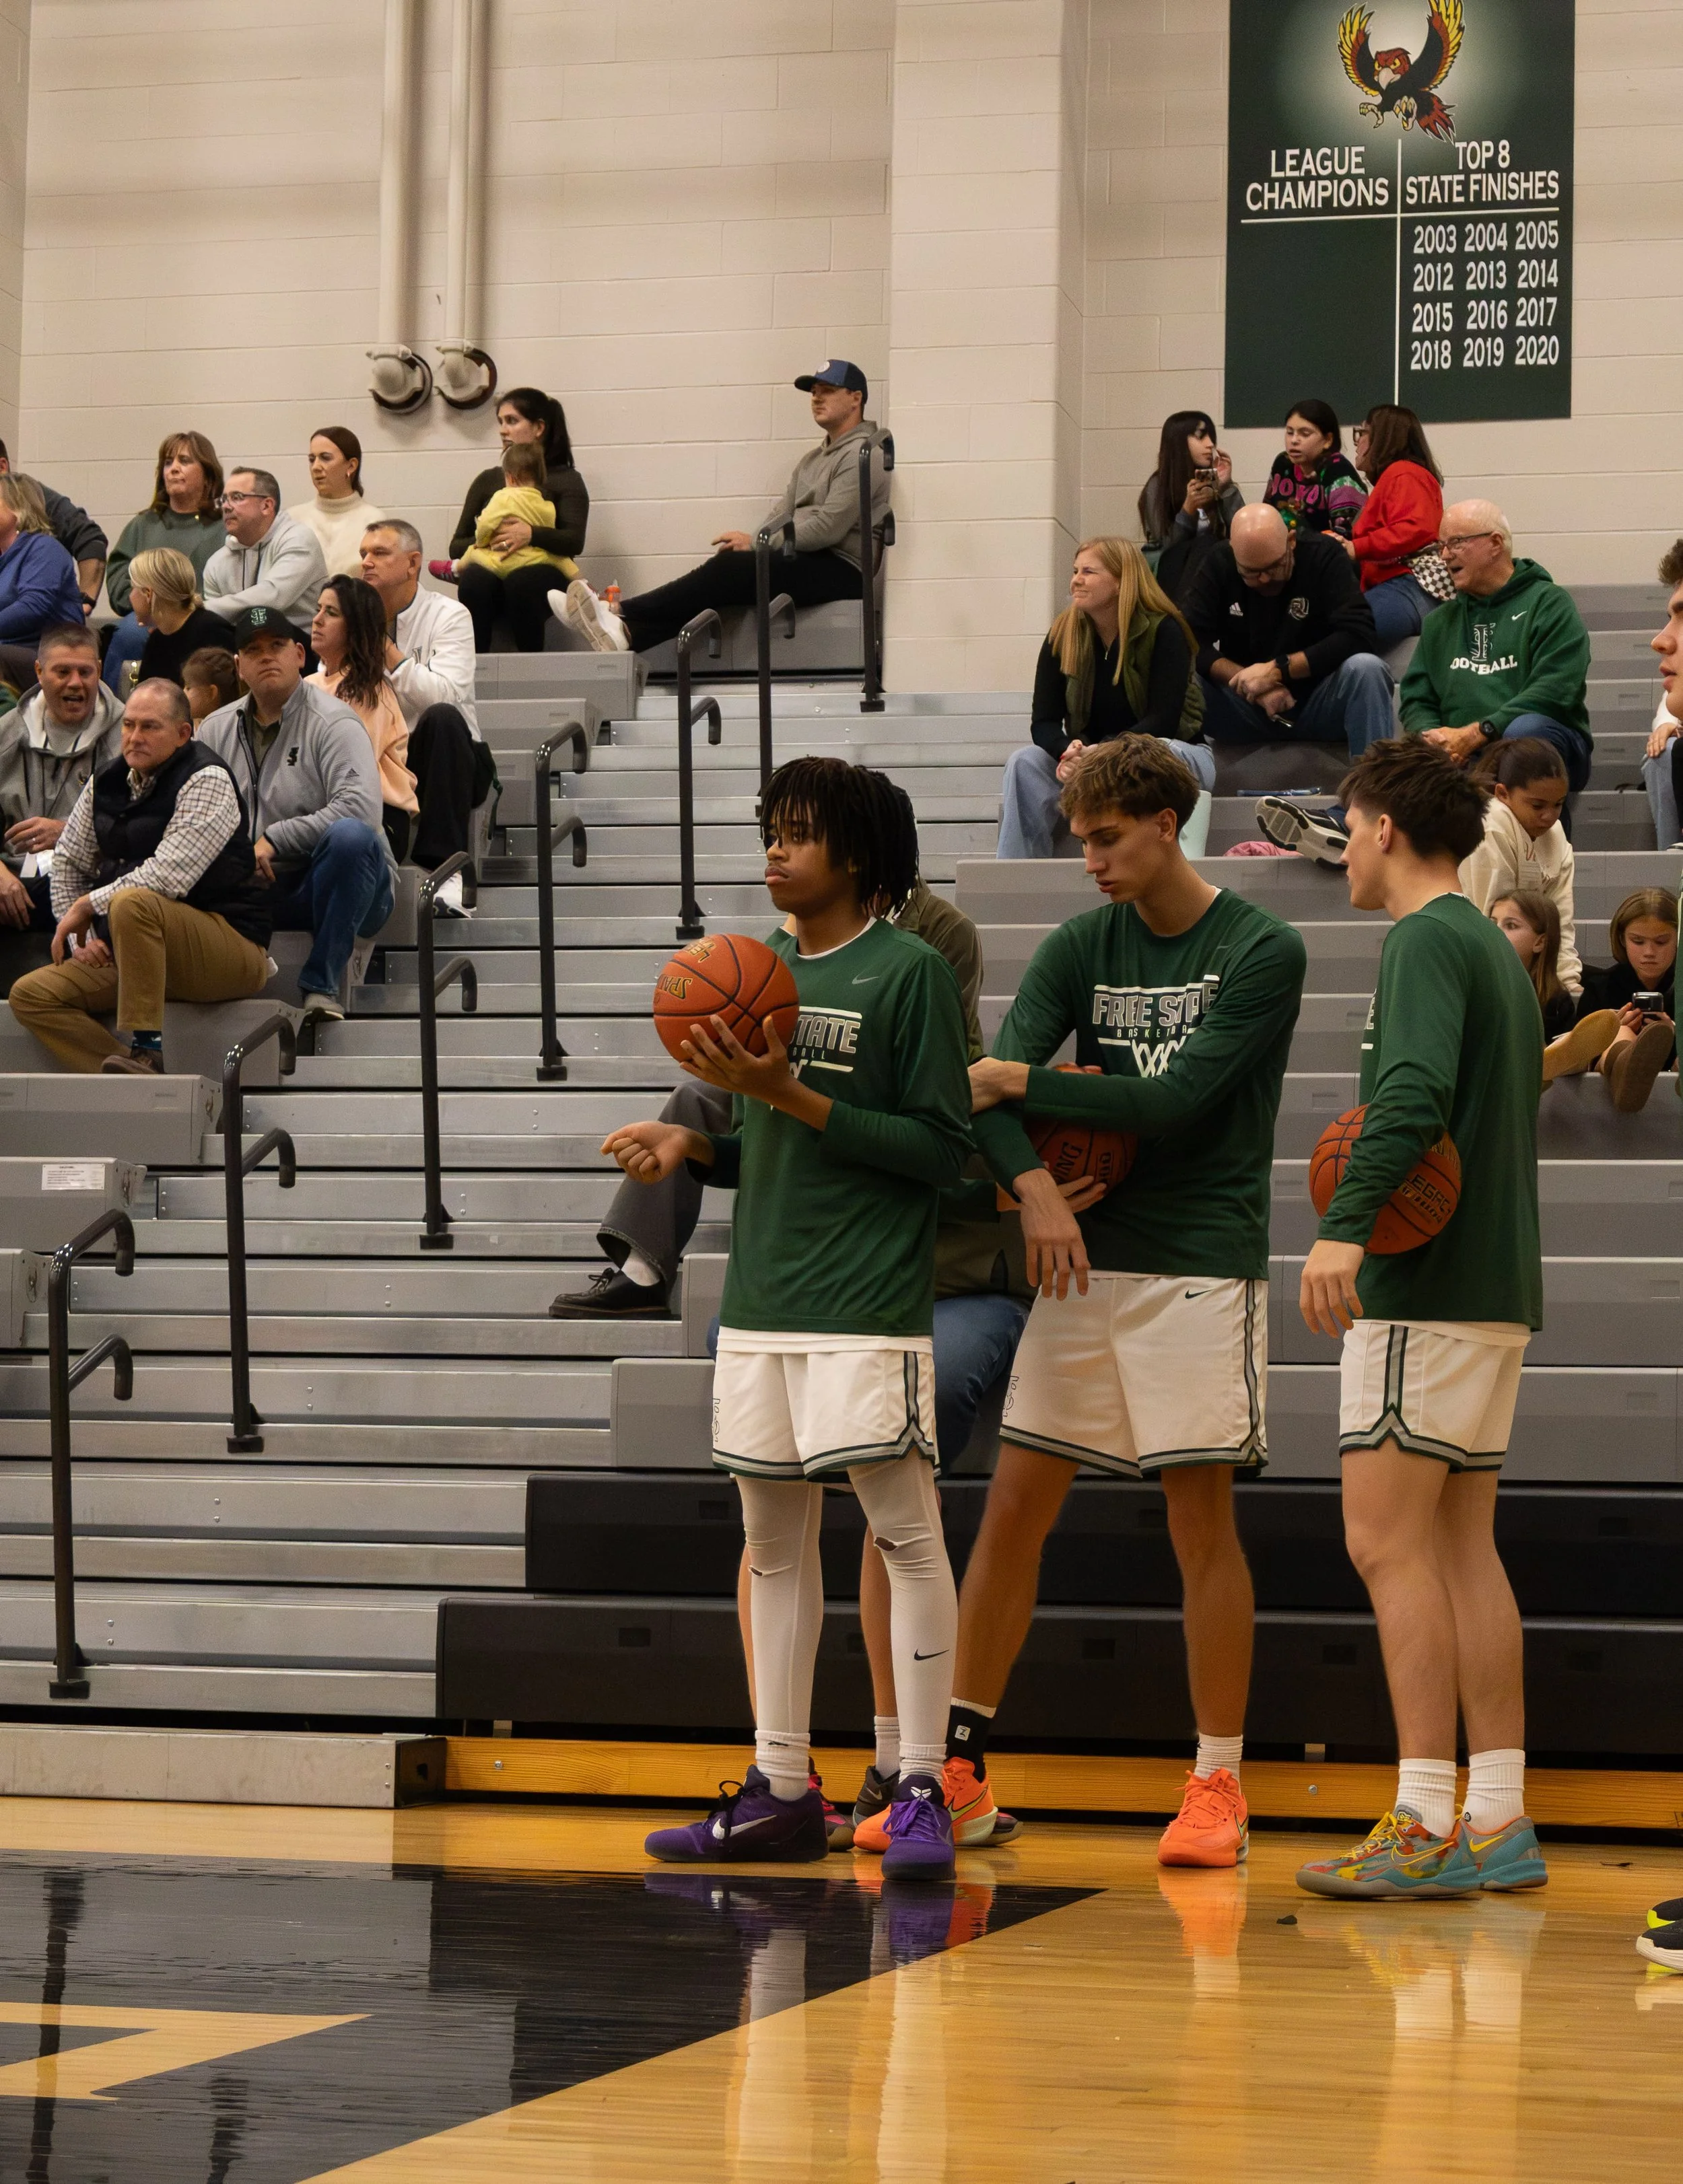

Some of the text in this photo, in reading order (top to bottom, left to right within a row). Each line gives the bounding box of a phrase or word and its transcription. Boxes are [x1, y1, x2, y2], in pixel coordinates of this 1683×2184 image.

[1271, 146, 1365, 177] LEAGUE
[1455, 140, 1510, 170] TOP 8
[1247, 178, 1389, 211] CHAMPIONS
[1406, 170, 1559, 204] STATE FINISHES
[1414, 220, 1558, 254] 2003 2004 2005
[1414, 259, 1558, 291] 2012 2013 2014
[1412, 297, 1557, 332] 2015 2016 2017
[1411, 335, 1558, 369] 2018 2019 2020
[1450, 655, 1518, 675] OOTBALL
[1092, 993, 1153, 1027] FREE
[790, 1014, 861, 1054] TATE
[1117, 1024, 1187, 1038] BASKETBA
